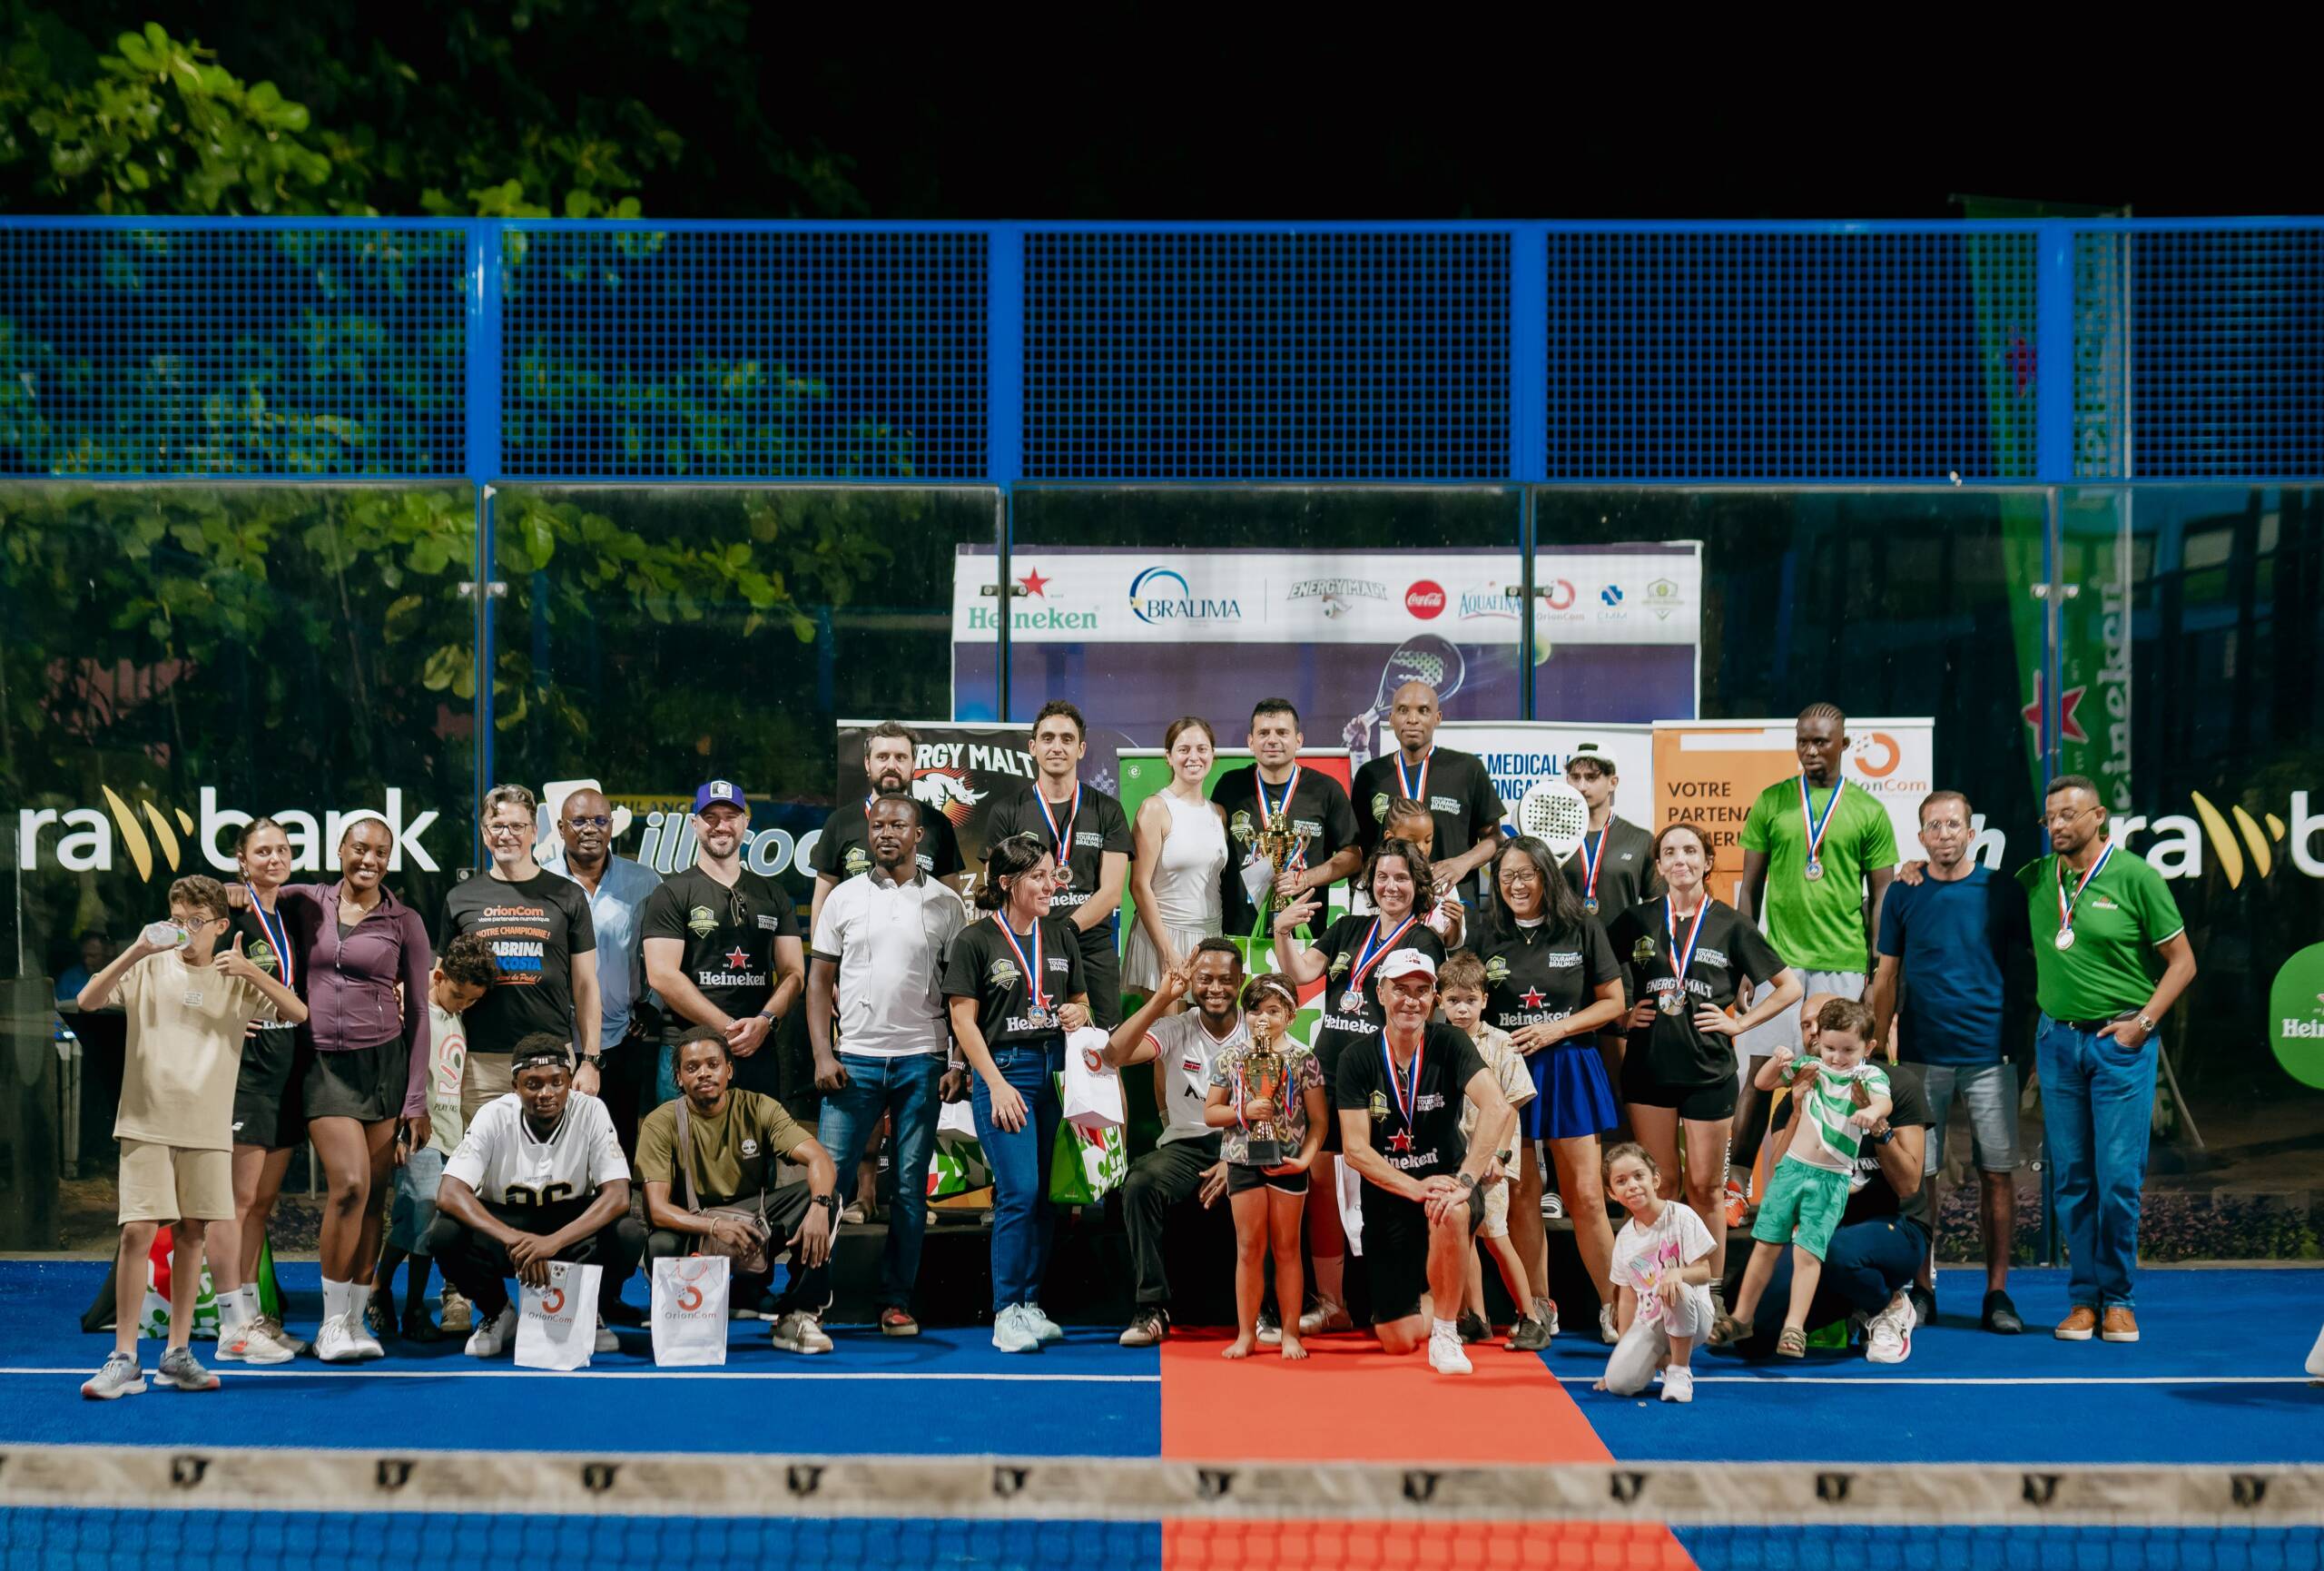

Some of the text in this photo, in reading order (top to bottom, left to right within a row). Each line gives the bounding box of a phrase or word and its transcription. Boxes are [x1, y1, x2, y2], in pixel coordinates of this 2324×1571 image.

[1286, 578, 1387, 600] ENERGY MALT
[1147, 599, 1241, 618] BRALIMA
[1458, 591, 1523, 618] AQUAFINA
[968, 608, 1098, 629] Heneken
[2097, 574, 2131, 815] eineken
[915, 744, 1035, 779] RGY MALT
[1488, 754, 1561, 776] MEDICAL
[1668, 782, 1731, 797] VOTRE
[1854, 778, 1926, 792] onCom
[483, 905, 544, 916] OrionCom
[487, 941, 544, 956] ABRINA
[497, 956, 542, 971] COSTA
[698, 972, 765, 986] Heineken
[1646, 978, 1713, 998] ENERGY MALT
[1324, 1013, 1379, 1034] Heineke
[1499, 1011, 1571, 1026] Heineken
[1384, 1152, 1439, 1170] ineken
[528, 1311, 574, 1324] OrionCom
[665, 1311, 717, 1319] OrionCom
